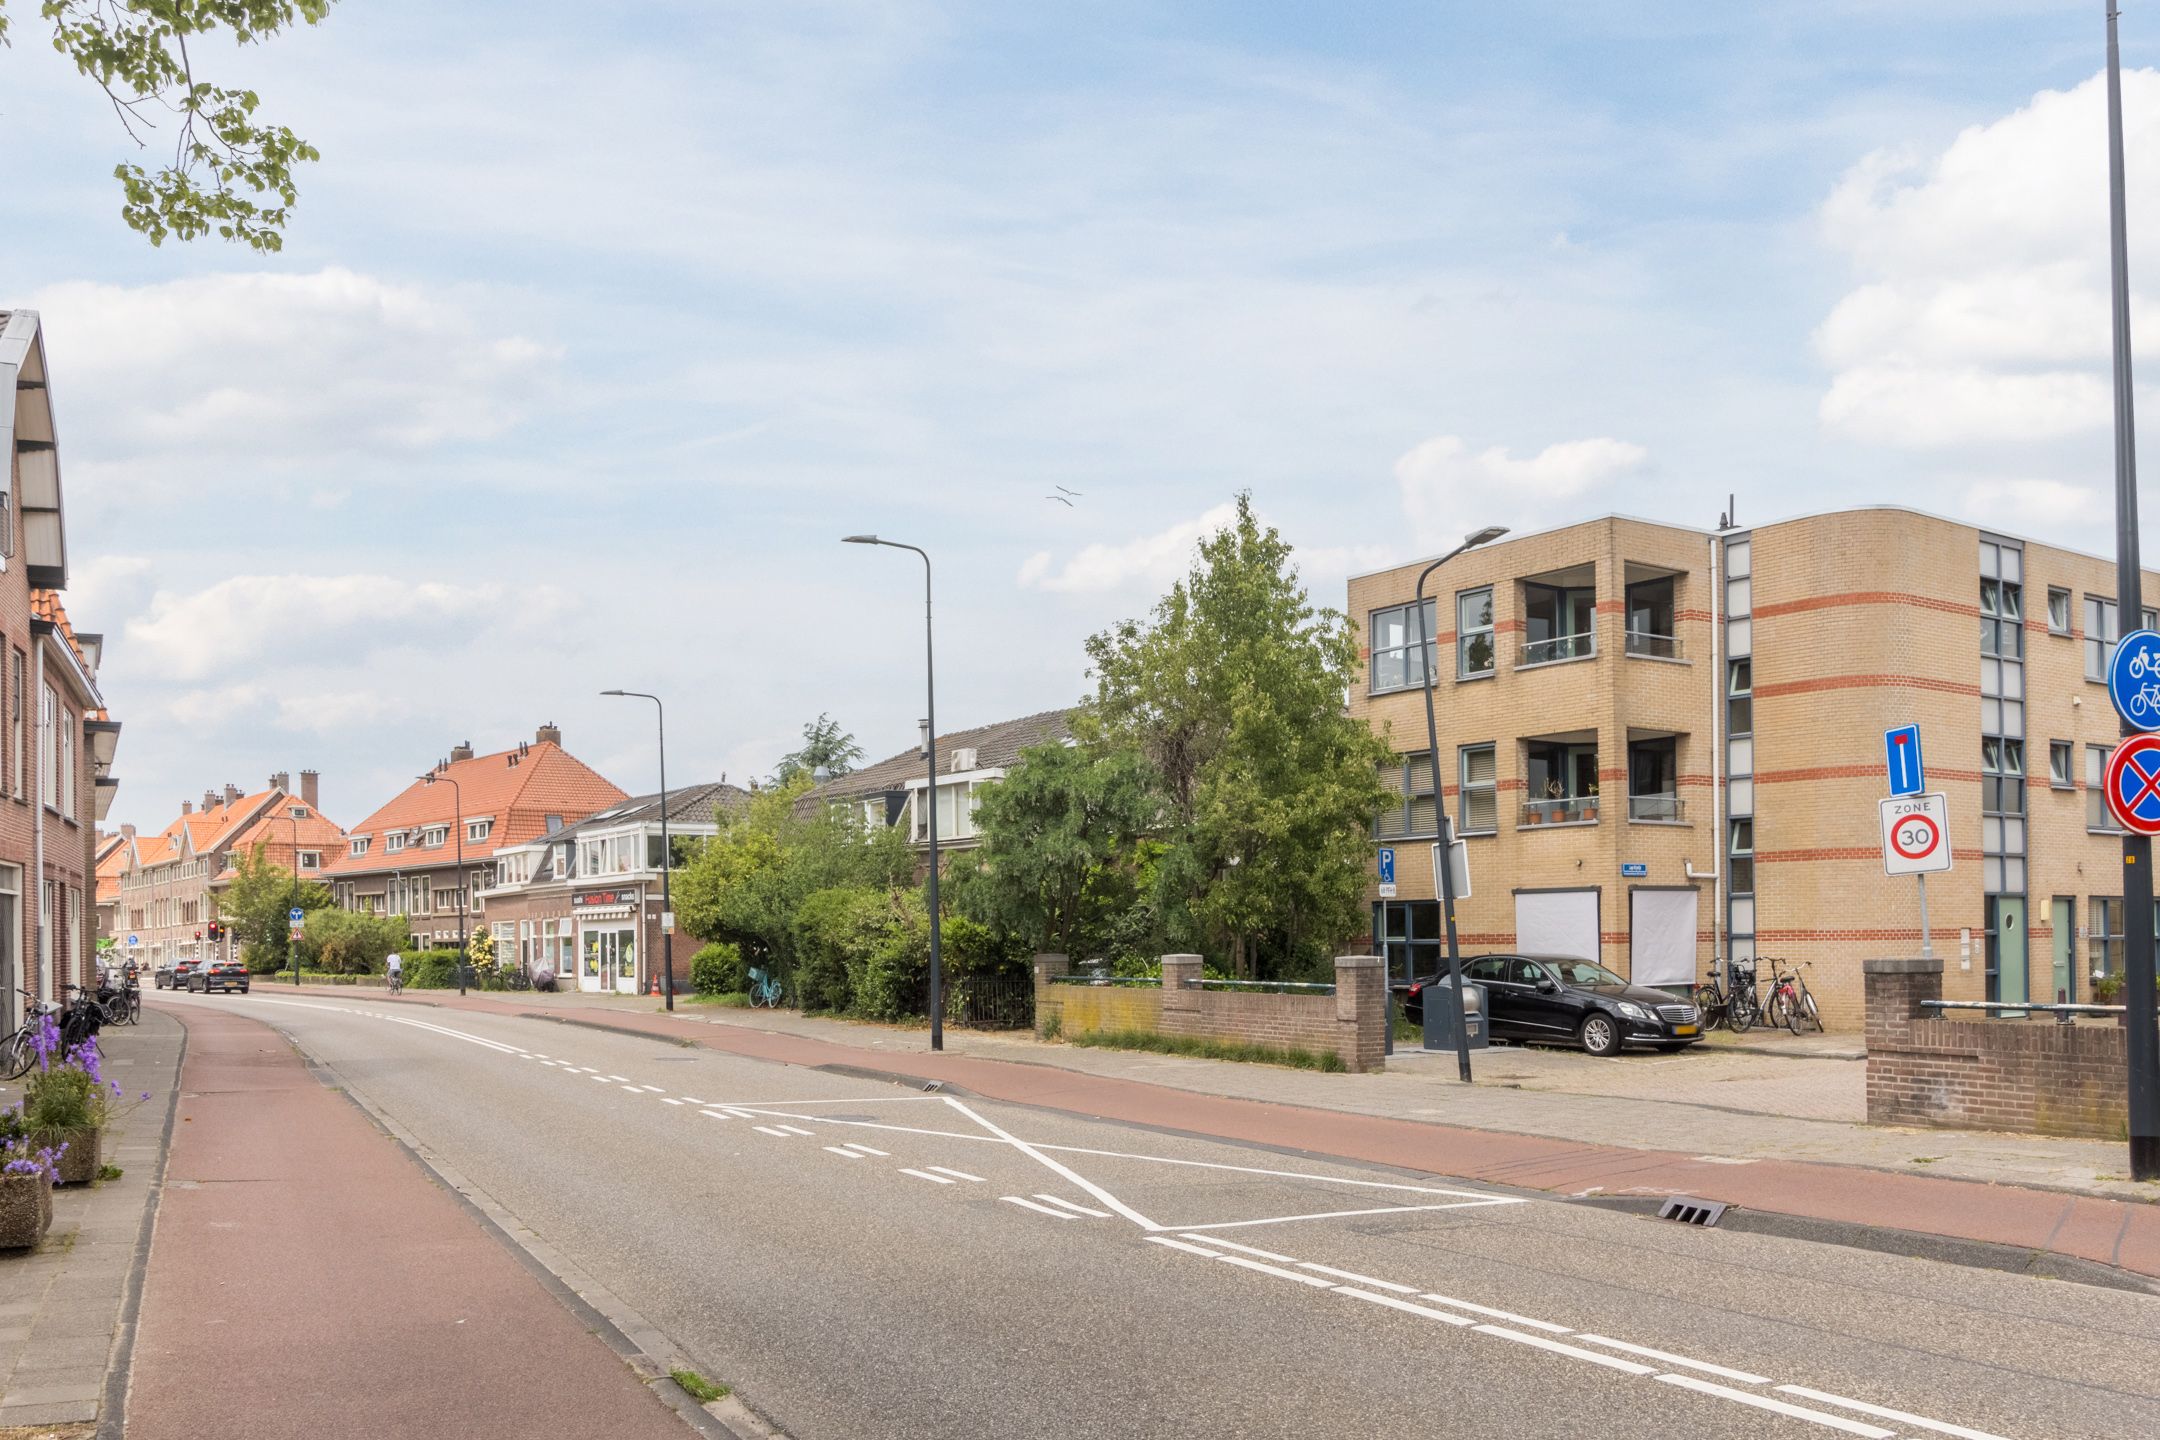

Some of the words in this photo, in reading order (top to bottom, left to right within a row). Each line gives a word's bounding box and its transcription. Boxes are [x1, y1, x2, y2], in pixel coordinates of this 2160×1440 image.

[1894, 802, 1931, 814] ZONE
[1902, 828, 1929, 846] 30
[1382, 851, 1392, 869] P
